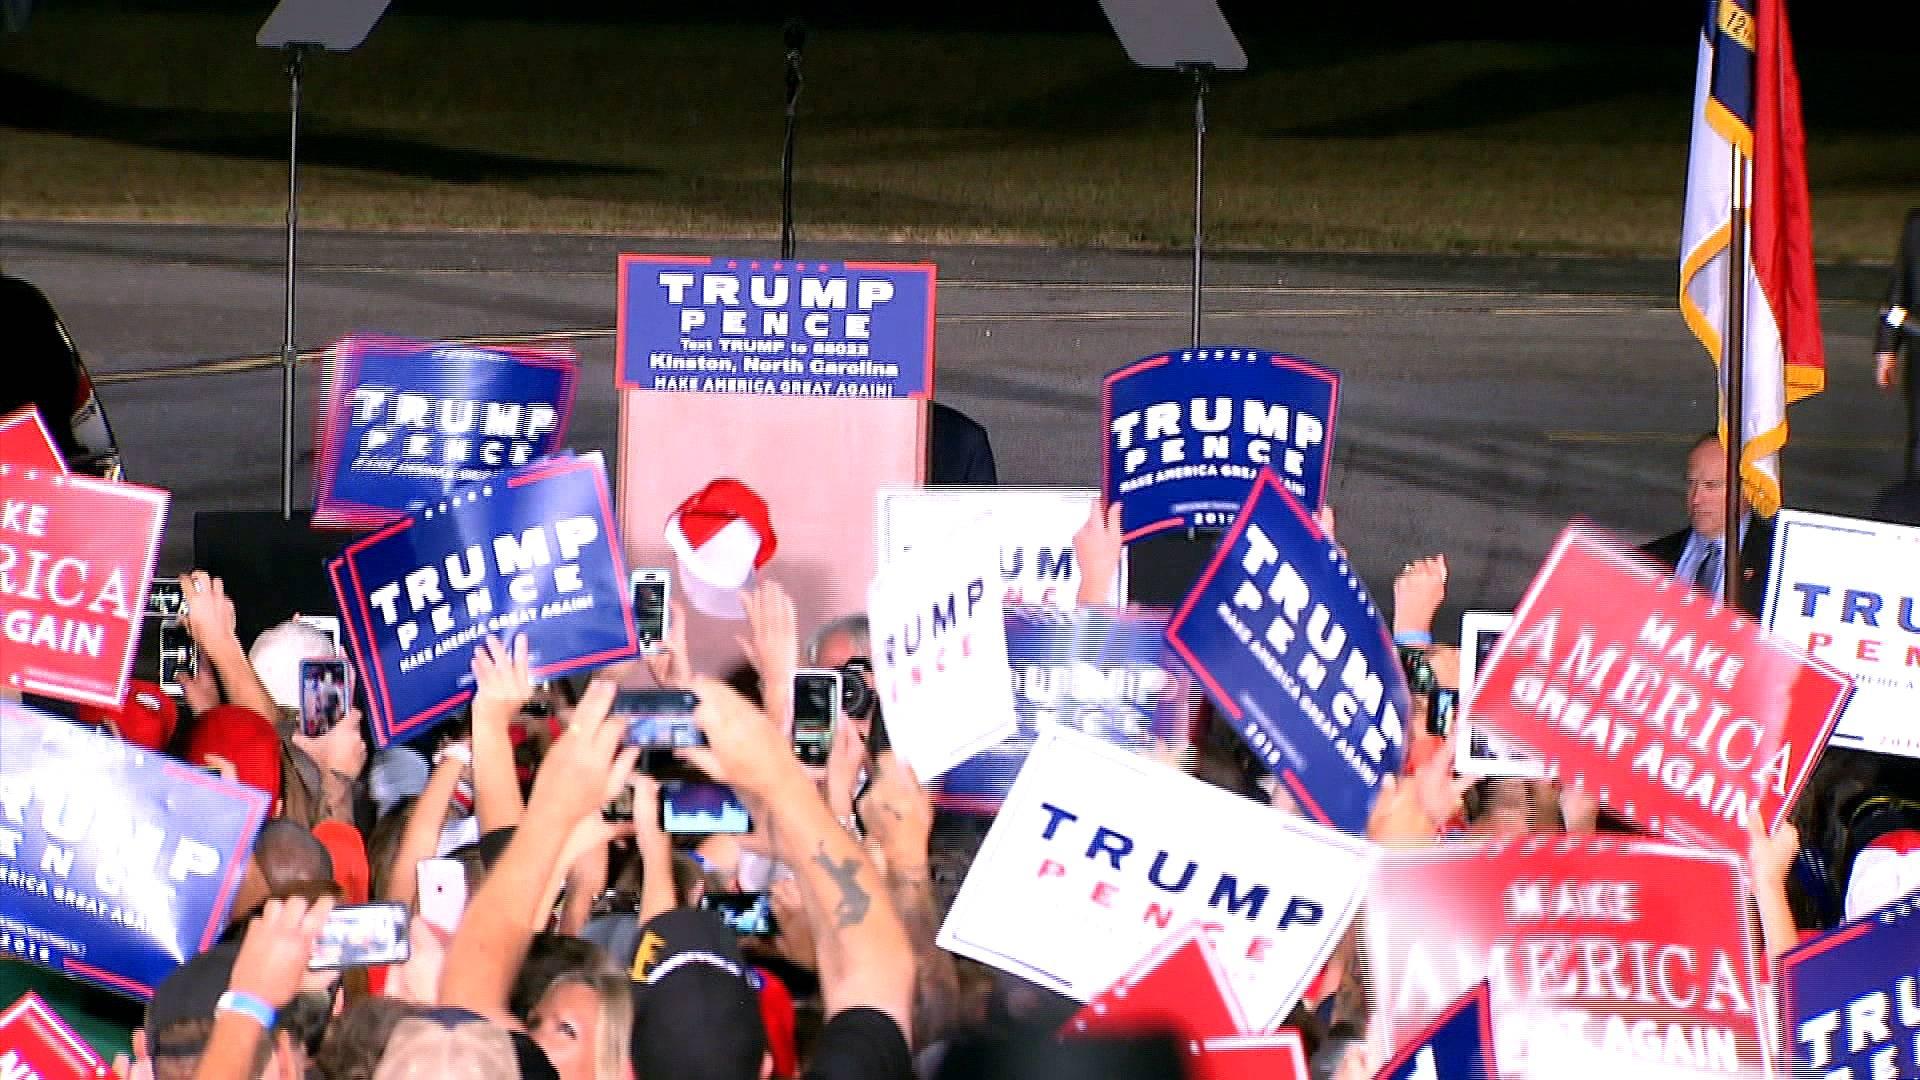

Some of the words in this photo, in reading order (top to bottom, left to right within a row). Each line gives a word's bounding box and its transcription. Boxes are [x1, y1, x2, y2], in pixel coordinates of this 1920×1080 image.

[658, 272, 895, 311] TRUMP
[680, 309, 872, 339] PENCE
[718, 338, 785, 353] TRUMP
[791, 343, 808, 354] to
[650, 352, 737, 373] Kinston,
[743, 356, 804, 374] North
[810, 358, 899, 377] Carolina
[653, 375, 699, 391] MAKE
[703, 377, 776, 394] AMERICA
[780, 380, 834, 396] GREAT
[350, 386, 560, 441] TRUMP
[1111, 397, 1324, 450] TRUMP
[1125, 436, 1305, 477] PENCE
[370, 516, 599, 626] TRUMP
[397, 563, 584, 651] PENCE
[1241, 522, 1404, 748] TRUMP
[1638, 608, 1746, 691] MAKE
[1232, 579, 1388, 764] PENCE
[1512, 608, 1794, 799] AMERICA
[1509, 667, 1638, 759] GREAT
[1631, 741, 1762, 831] AGAIN
[1040, 802, 1325, 931] TRUMP
[1503, 879, 1641, 922] MAKE
